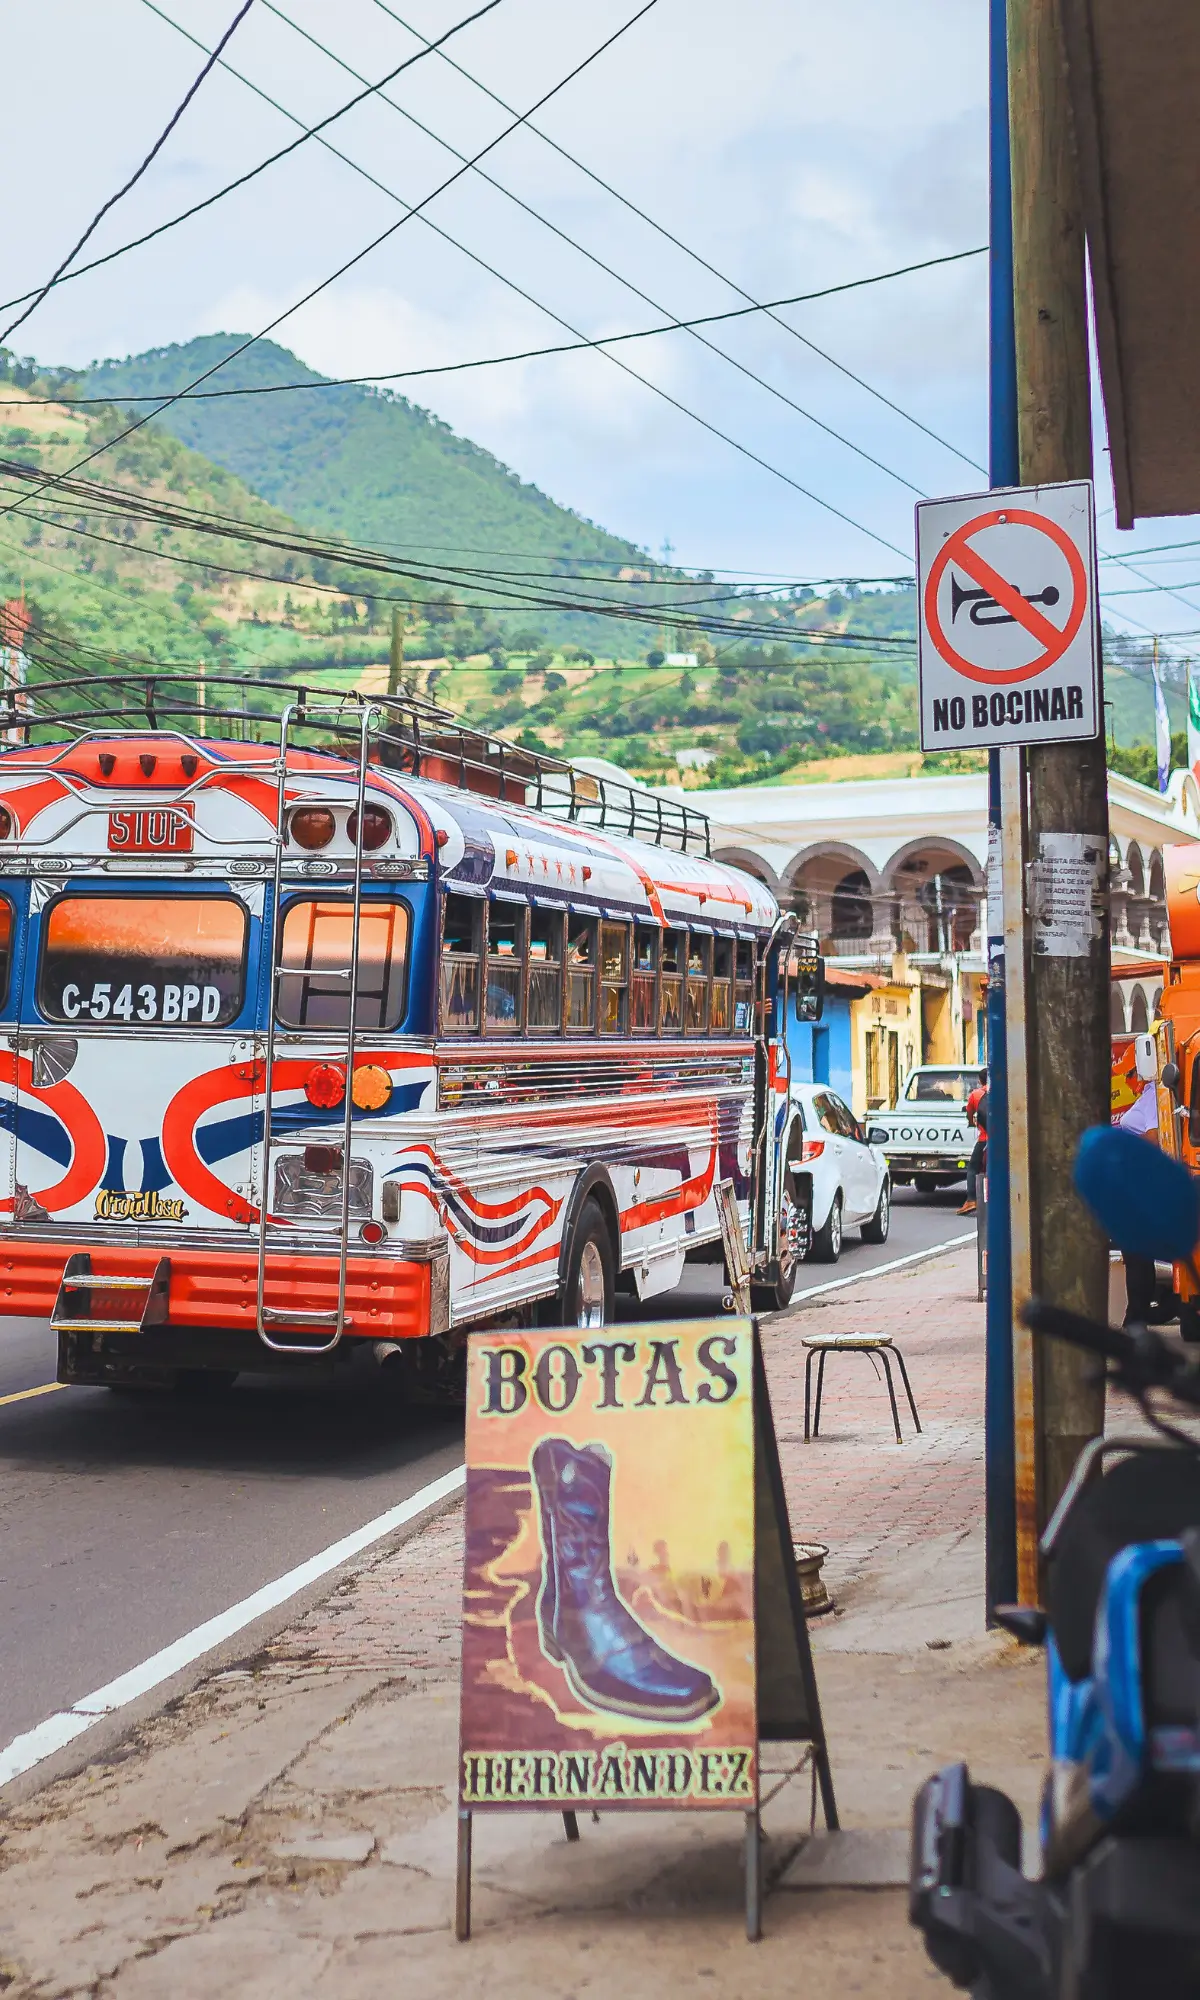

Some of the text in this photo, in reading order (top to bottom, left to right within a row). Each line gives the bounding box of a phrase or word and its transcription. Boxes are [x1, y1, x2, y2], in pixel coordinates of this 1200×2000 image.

[933, 685, 1083, 732] NO BOCINAR
[111, 807, 189, 845] STOP
[889, 1127, 964, 1142] TOYOTA
[479, 1335, 739, 1415] BOTAS
